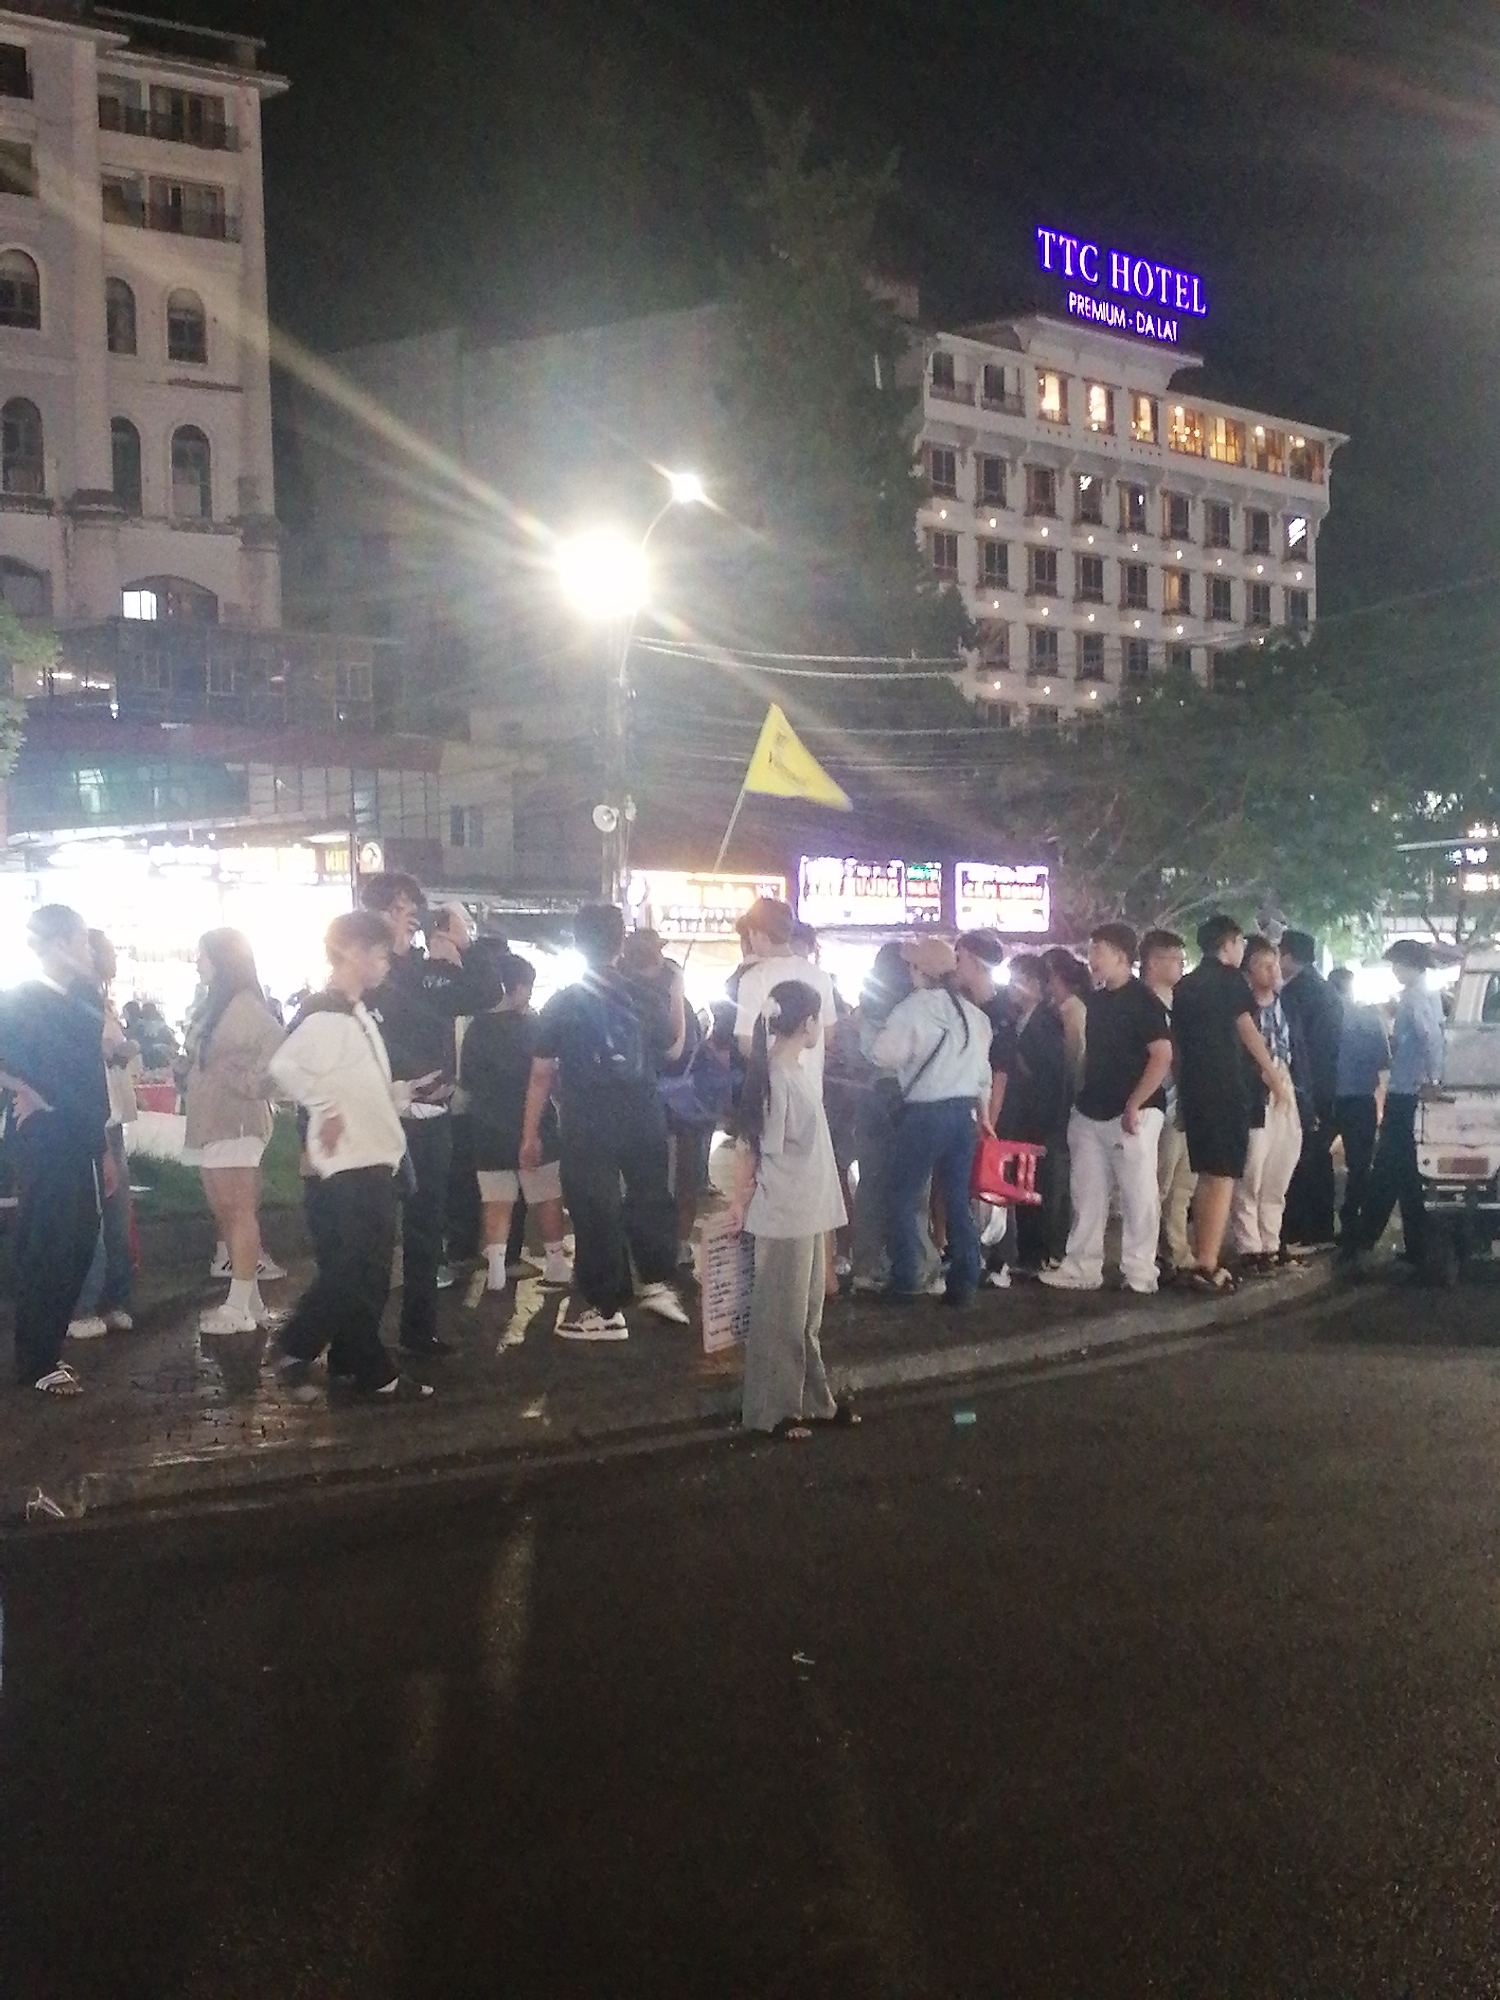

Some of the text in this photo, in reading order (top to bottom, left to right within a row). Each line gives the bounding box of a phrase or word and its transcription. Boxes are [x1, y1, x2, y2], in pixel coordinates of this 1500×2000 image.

[1037, 227, 1207, 315] TTC HOTEL
[1068, 290, 1126, 329] PREMIUM
